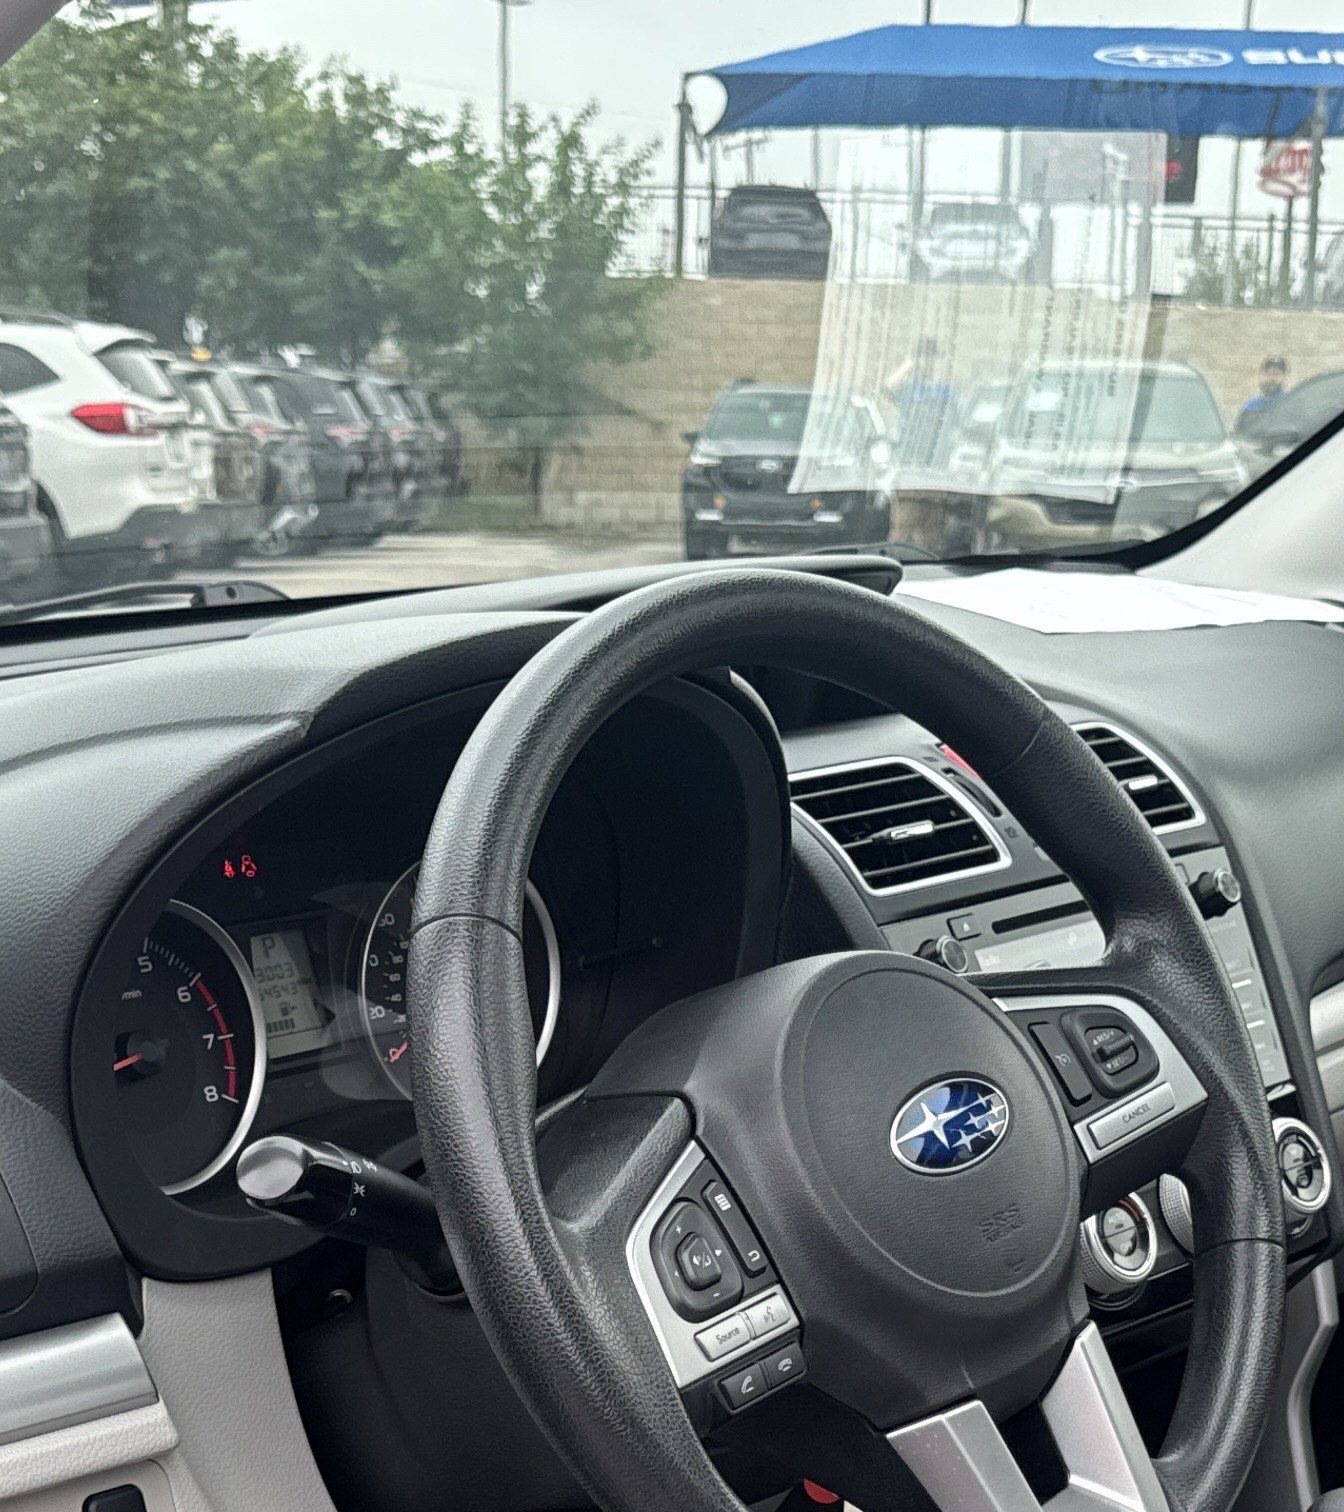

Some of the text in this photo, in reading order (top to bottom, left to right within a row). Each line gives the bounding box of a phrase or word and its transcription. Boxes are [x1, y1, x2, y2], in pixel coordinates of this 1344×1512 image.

[261, 936, 275, 958] P
[137, 955, 153, 974] 5
[176, 985, 192, 1003] 6
[202, 1033, 215, 1050] 7
[203, 1085, 219, 1102] 8
[1122, 1103, 1152, 1124] CANCEL
[716, 1327, 741, 1345] Source
